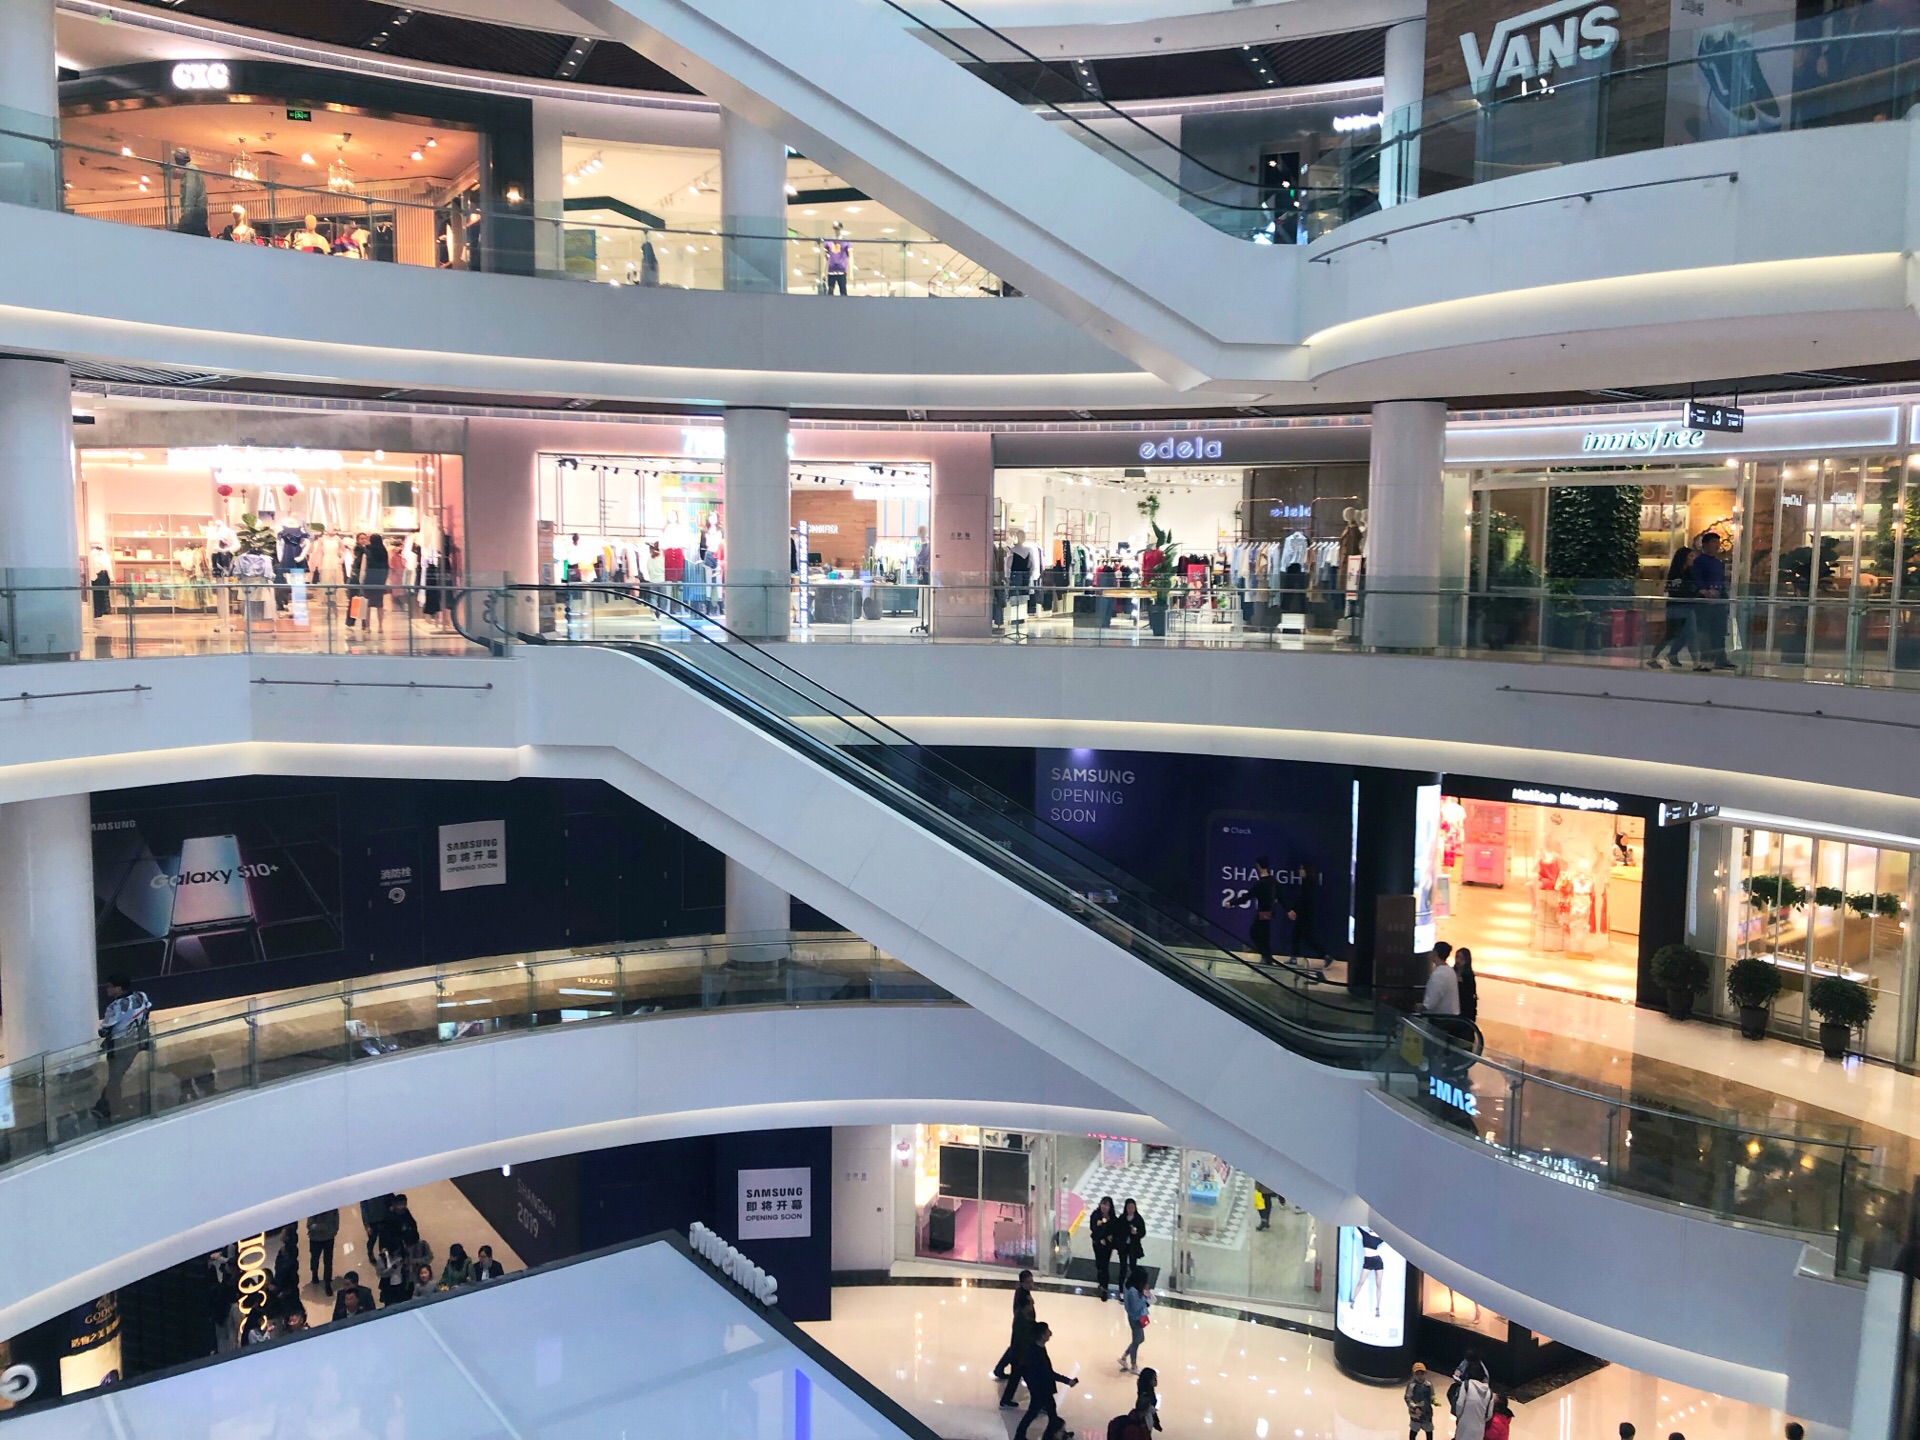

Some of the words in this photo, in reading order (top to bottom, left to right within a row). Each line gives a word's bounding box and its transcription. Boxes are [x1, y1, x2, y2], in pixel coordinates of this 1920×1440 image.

[1459, 0, 1620, 95] VANS
[1583, 422, 1705, 454] innisfree
[1139, 436, 1222, 459] edela
[1051, 767, 1136, 785] SAMSUNG
[1051, 788, 1124, 805] OPENING
[1050, 807, 1096, 823] SOON
[1688, 801, 1699, 817] L2
[91, 820, 137, 831] AMSUNG
[446, 838, 498, 851] SAMSUNG
[446, 864, 476, 873] OPENING
[477, 862, 498, 870] SOON
[149, 868, 233, 889] Galaxy
[236, 863, 280, 880] S10+
[1222, 866, 1323, 886] SHAGHI
[746, 1187, 803, 1199] SAMSUNG
[746, 1199, 803, 1212] 即将开幕
[745, 1213, 779, 1222] OPENING
